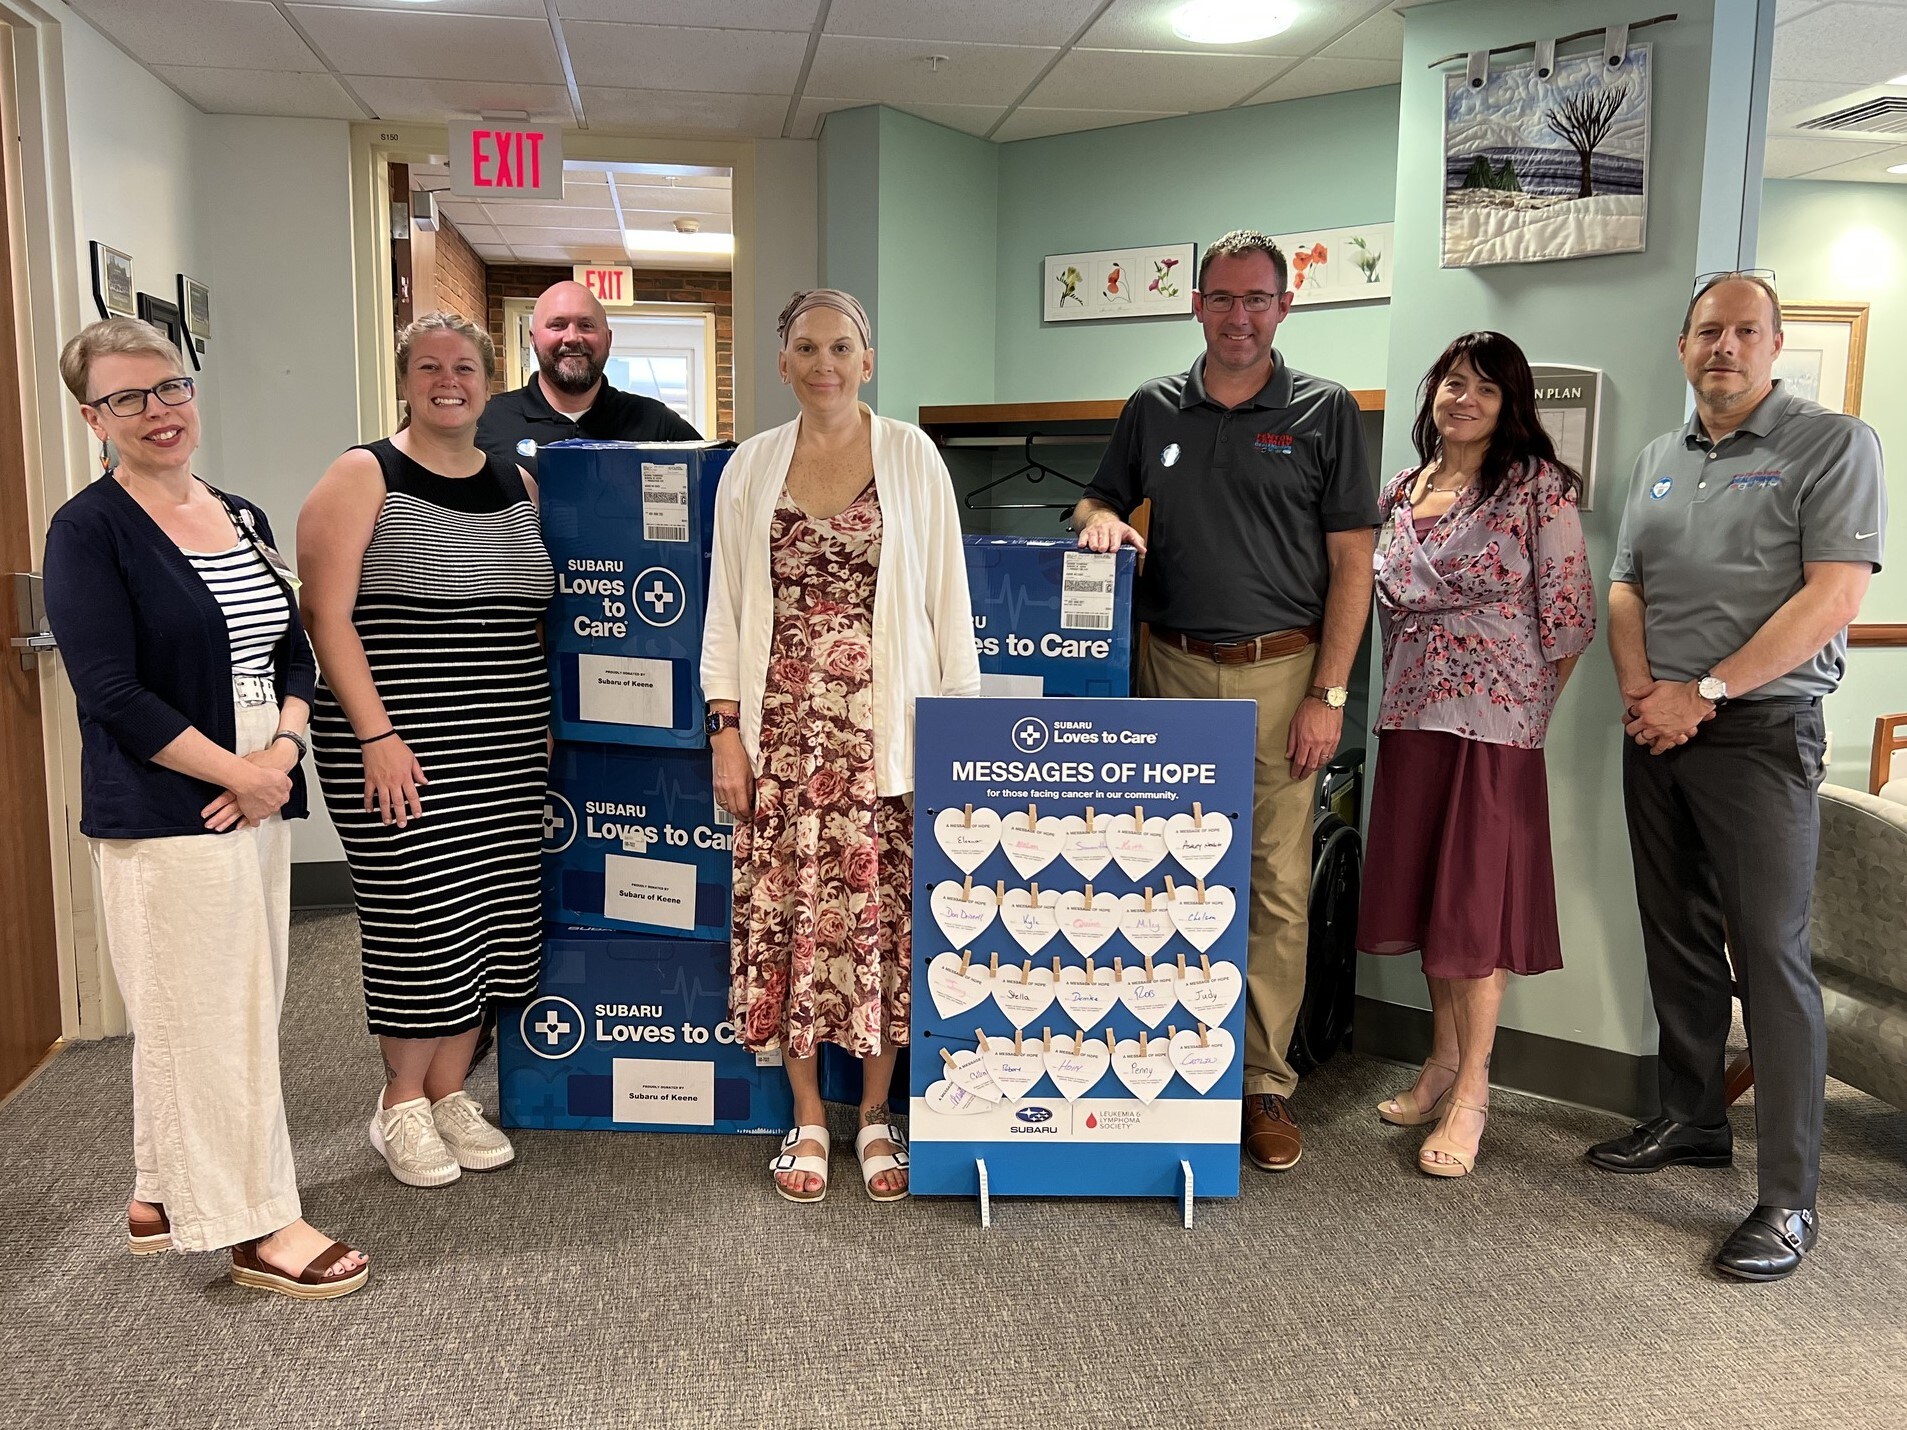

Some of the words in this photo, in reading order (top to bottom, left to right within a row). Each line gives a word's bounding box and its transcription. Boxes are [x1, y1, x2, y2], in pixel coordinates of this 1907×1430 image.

[380, 133, 398, 141] S150
[471, 130, 544, 188] EXIT
[586, 270, 623, 300] EXIT
[1547, 387, 1581, 399] PLAN
[568, 559, 623, 572] SUBARU
[559, 573, 625, 596] Loves
[602, 598, 626, 618] to
[574, 616, 627, 638] Care
[1006, 634, 1034, 656] to
[1040, 634, 1110, 658] Care
[1054, 730, 1098, 744] Loves
[1102, 731, 1117, 744] to
[1120, 730, 1157, 745] Care
[952, 761, 1094, 783] MESSAGES
[1101, 763, 1136, 783] OF
[1144, 764, 1216, 784] HOPE
[987, 789, 1000, 798] for
[1002, 789, 1028, 798] those
[1030, 789, 1059, 800] facing
[1095, 790, 1104, 799] in
[1124, 790, 1179, 800] community.
[586, 801, 646, 818] SUBARU
[664, 824, 688, 847] to
[694, 826, 733, 850] Car
[619, 890, 645, 899] Subaru
[657, 894, 681, 904] Keene
[1007, 990, 1029, 1000] Stella
[1195, 989, 1217, 1002] Judy
[595, 1004, 663, 1017] SUBARU
[596, 1020, 675, 1043] Loves
[682, 1022, 709, 1044] to
[1132, 1062, 1153, 1078] Penny
